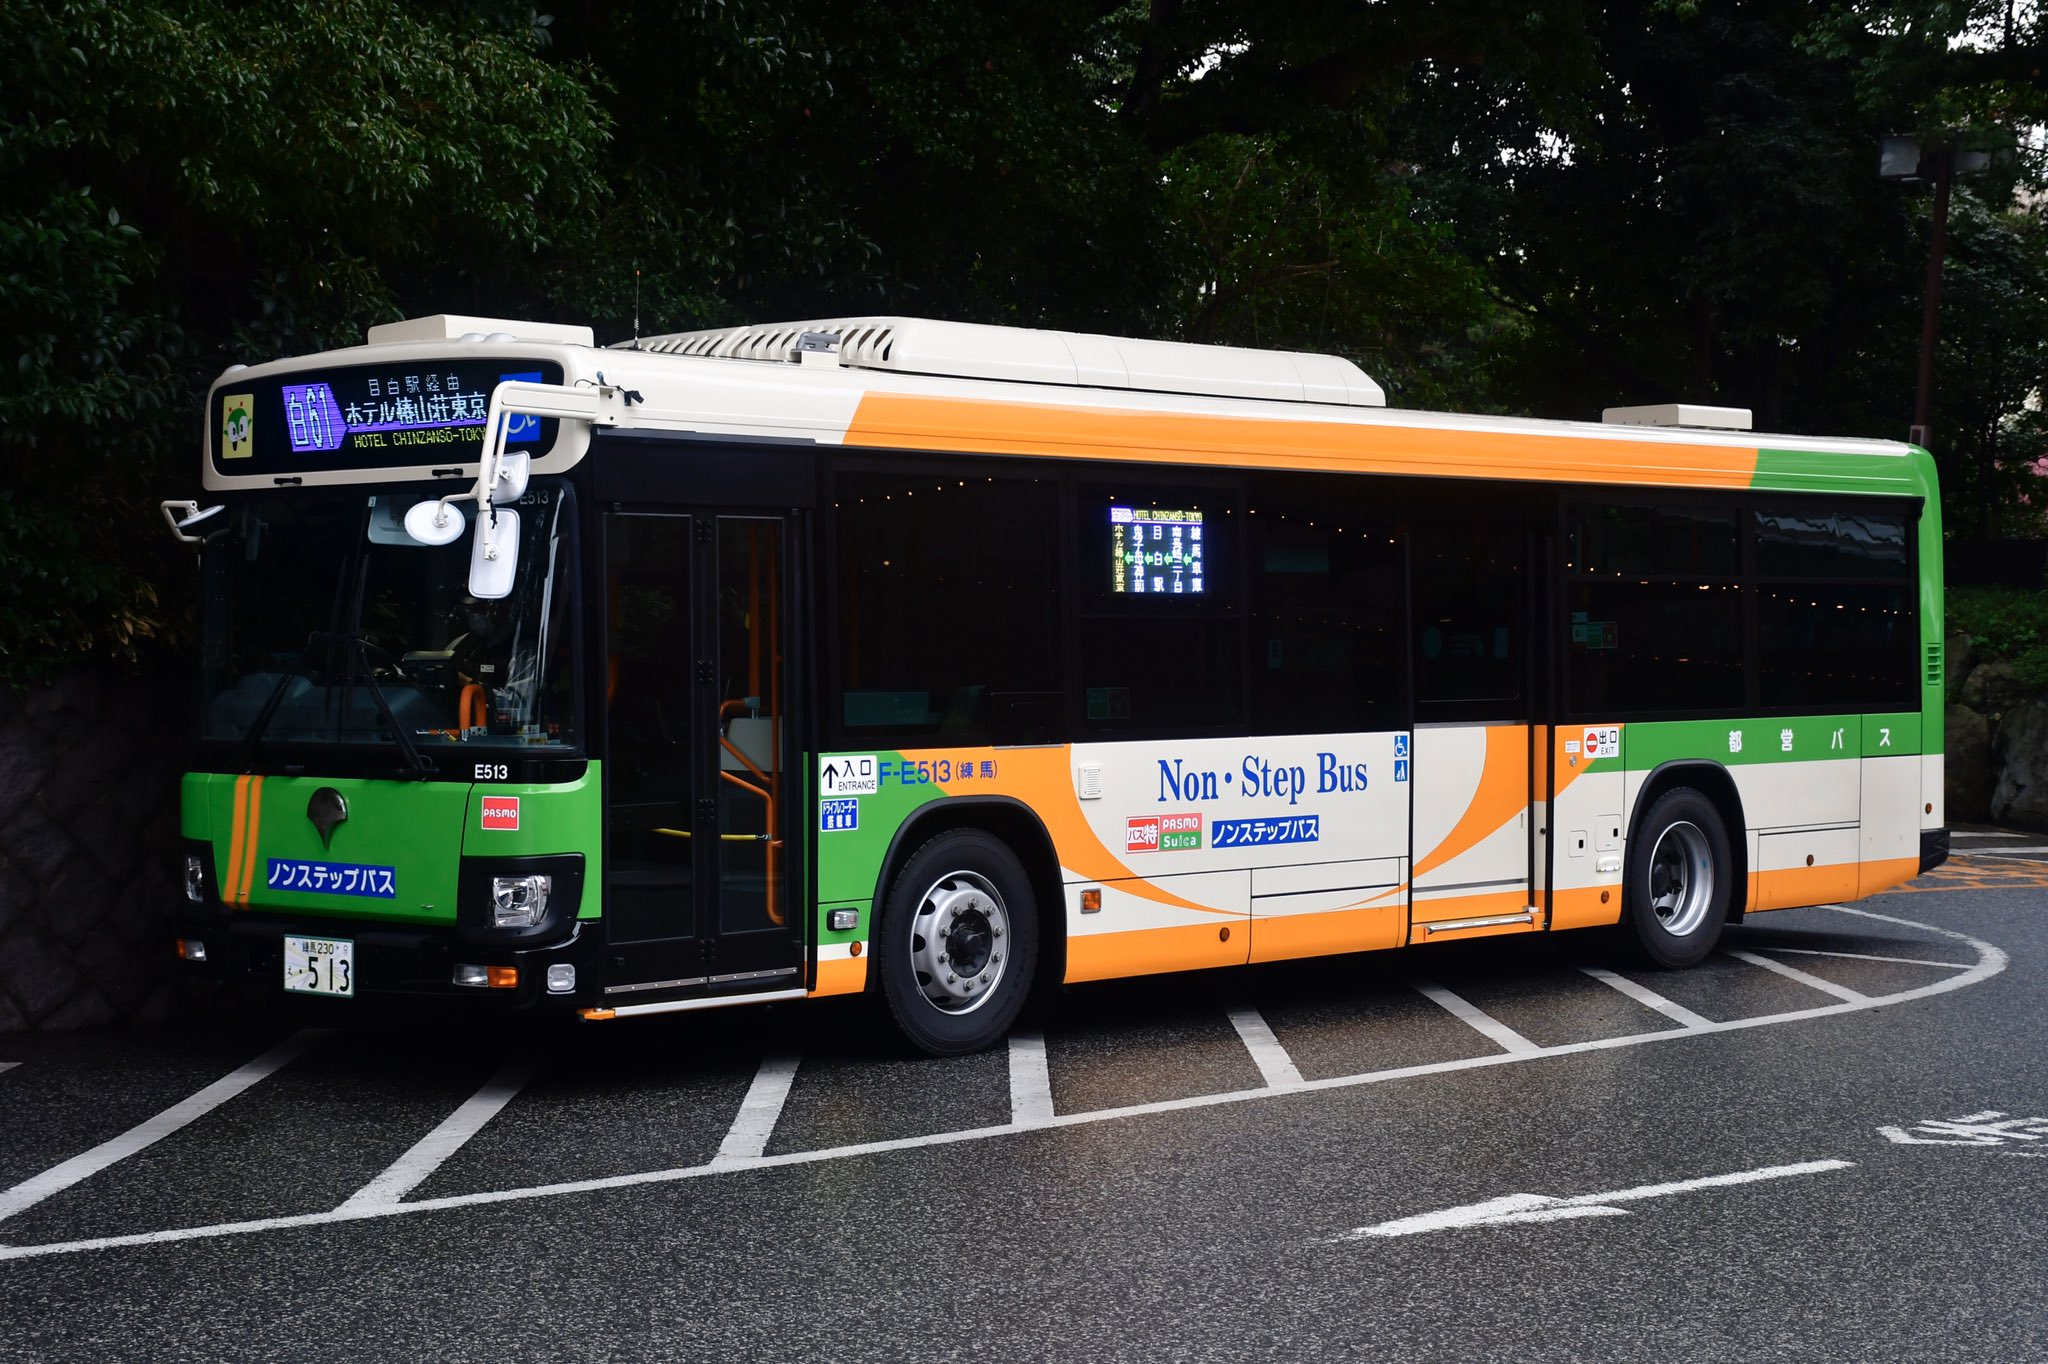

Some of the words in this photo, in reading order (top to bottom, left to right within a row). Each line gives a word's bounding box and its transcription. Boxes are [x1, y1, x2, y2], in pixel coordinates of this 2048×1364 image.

[368, 374, 460, 396] 目白駅経由
[289, 387, 334, 448] 白61
[345, 391, 487, 427] ホテル椿山荘東京
[354, 434, 388, 448] HOTEL
[392, 427, 487, 446] CHINZANSŌ-TOKY
[1133, 510, 1151, 521] HOTEL
[1153, 525, 1165, 592] 目白駅
[1599, 730, 1618, 745] 出口
[1728, 728, 1891, 753] 都営バス
[1601, 746, 1615, 755] EXIT
[474, 764, 508, 780] E513
[842, 759, 872, 778] 入口
[879, 760, 951, 786] F-E513
[1316, 751, 1368, 793] Bus
[838, 779, 876, 791] ENTRANCE
[483, 808, 516, 820] PASMO
[1162, 817, 1199, 830] PASMO
[1128, 823, 1158, 845] バス特
[1163, 834, 1197, 848] Suica
[1212, 820, 1319, 846] ノンステップバス
[268, 863, 395, 894] ノンステップバス
